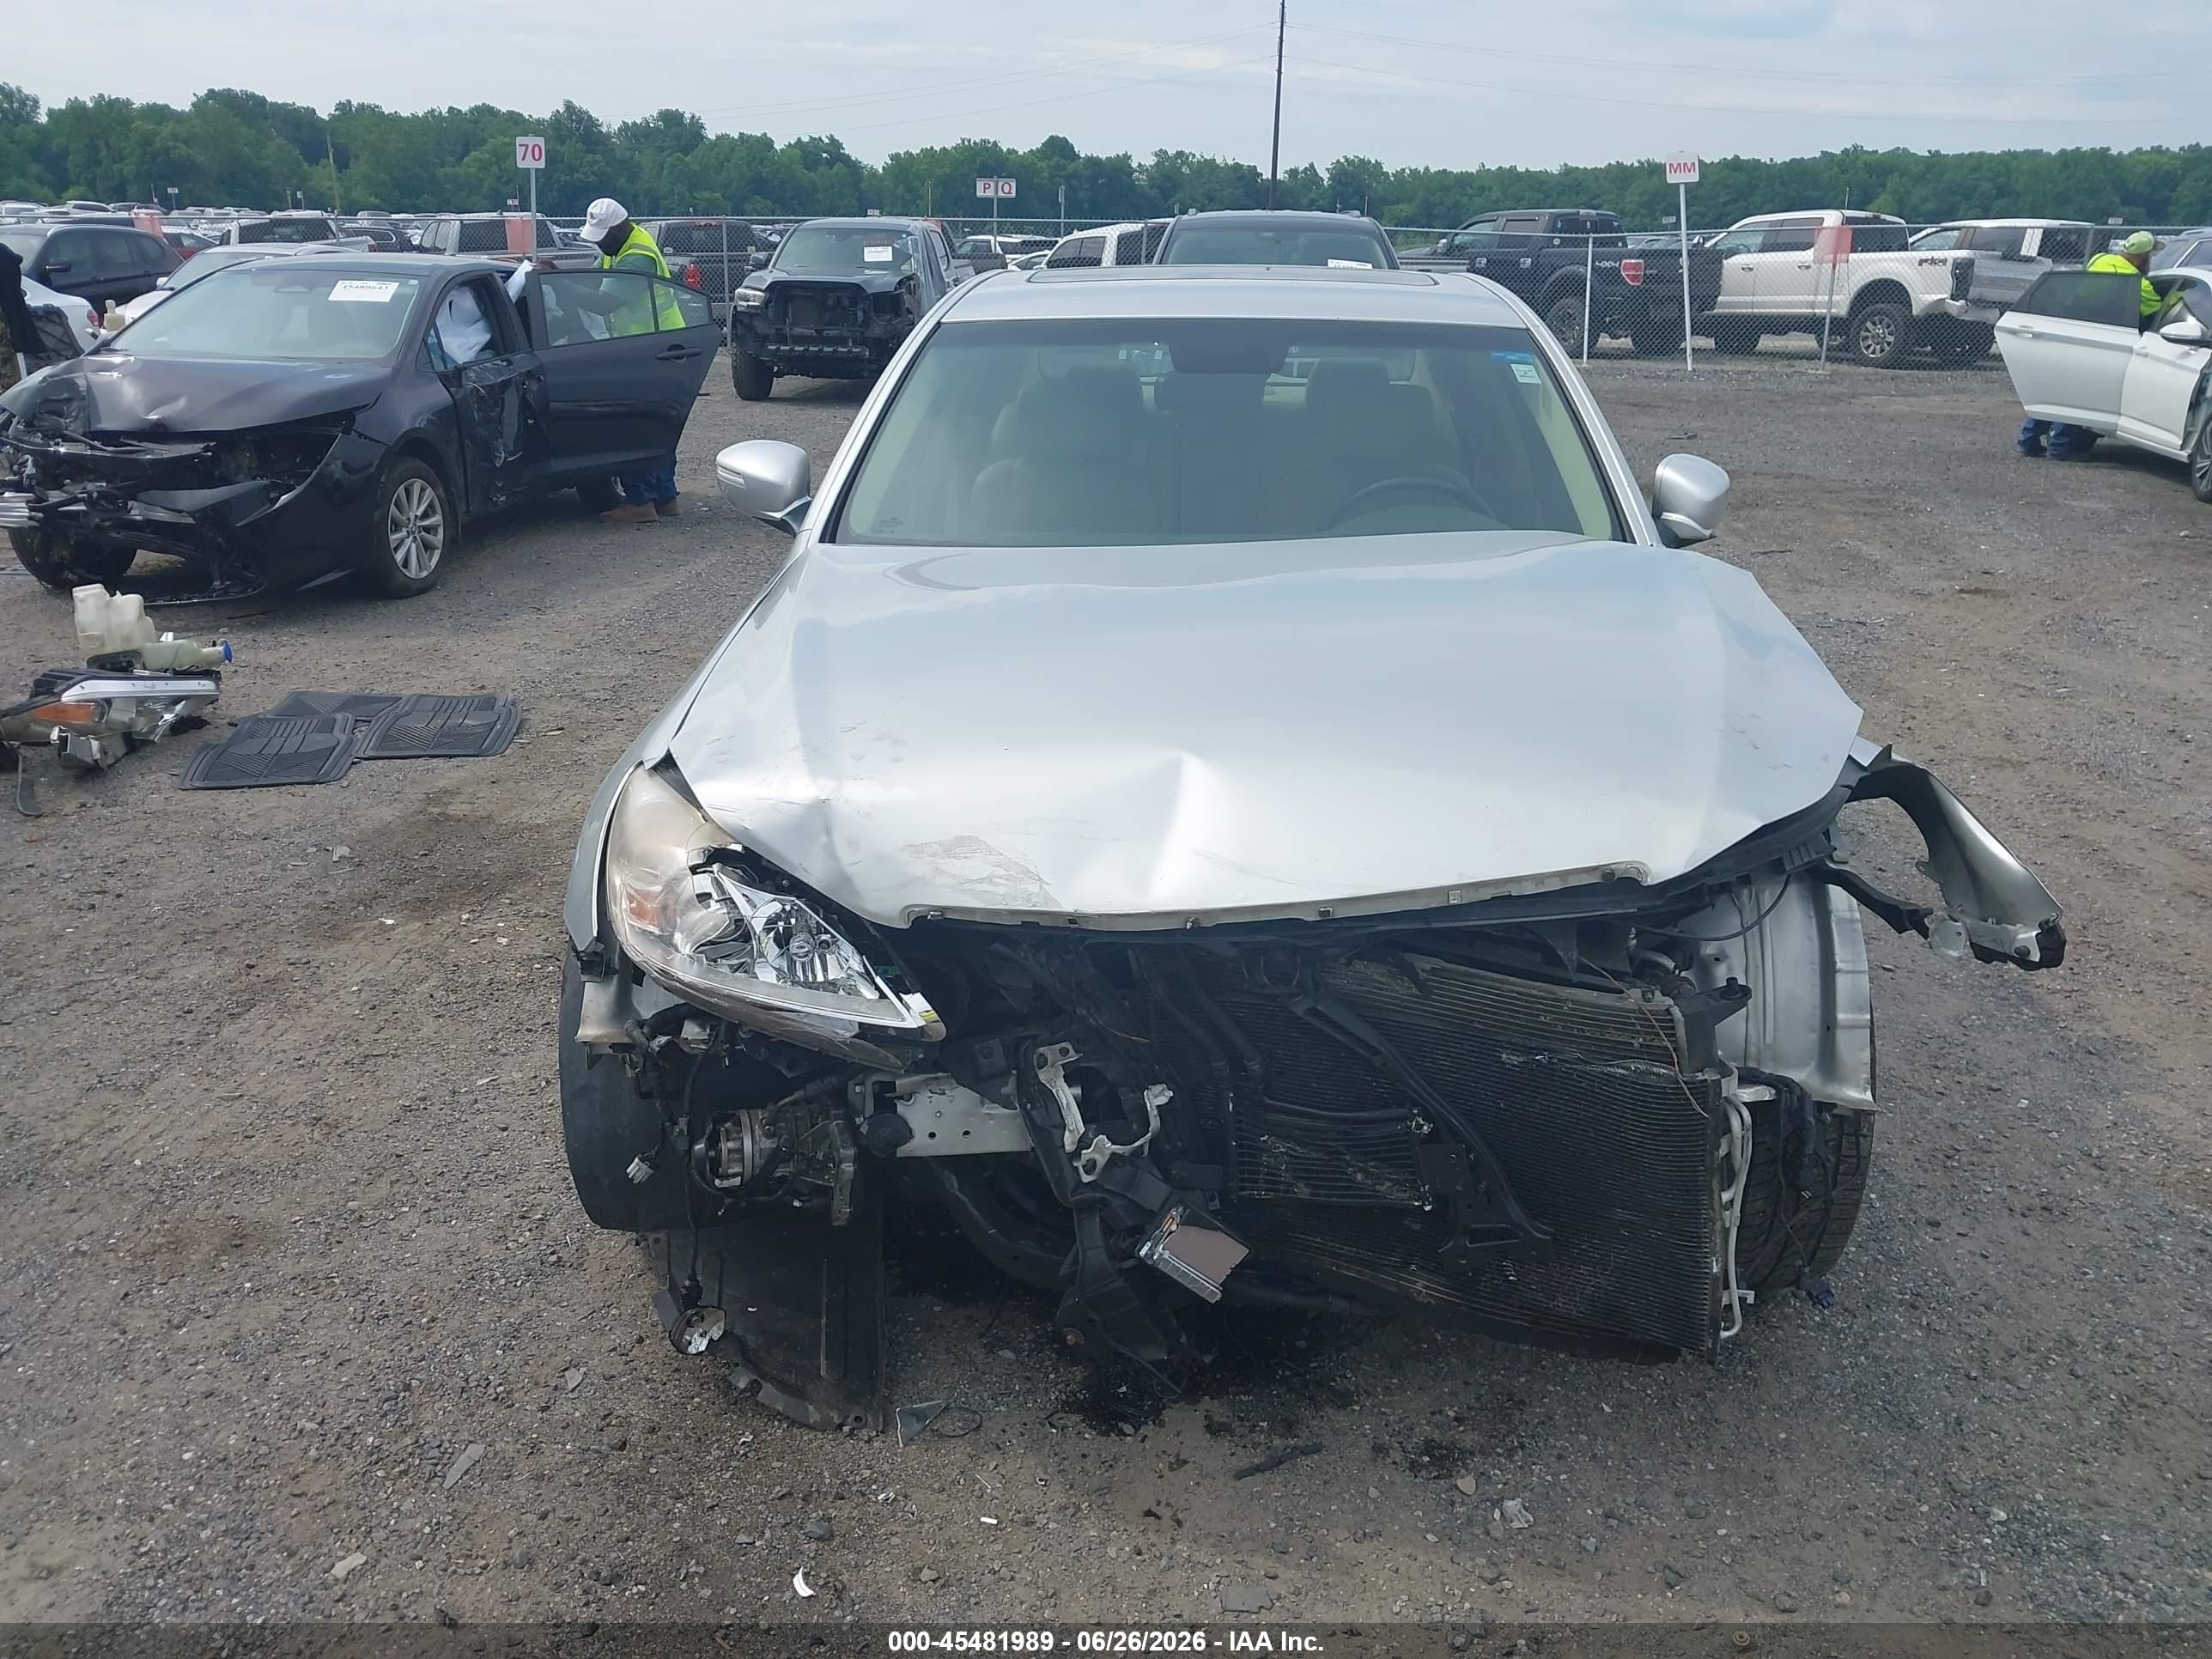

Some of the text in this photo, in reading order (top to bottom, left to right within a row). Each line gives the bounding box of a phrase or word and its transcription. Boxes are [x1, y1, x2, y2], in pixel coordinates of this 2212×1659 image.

[519, 143, 543, 161] 70
[1669, 161, 1696, 174] MM
[982, 182, 991, 194] P
[1000, 181, 1013, 195] Q
